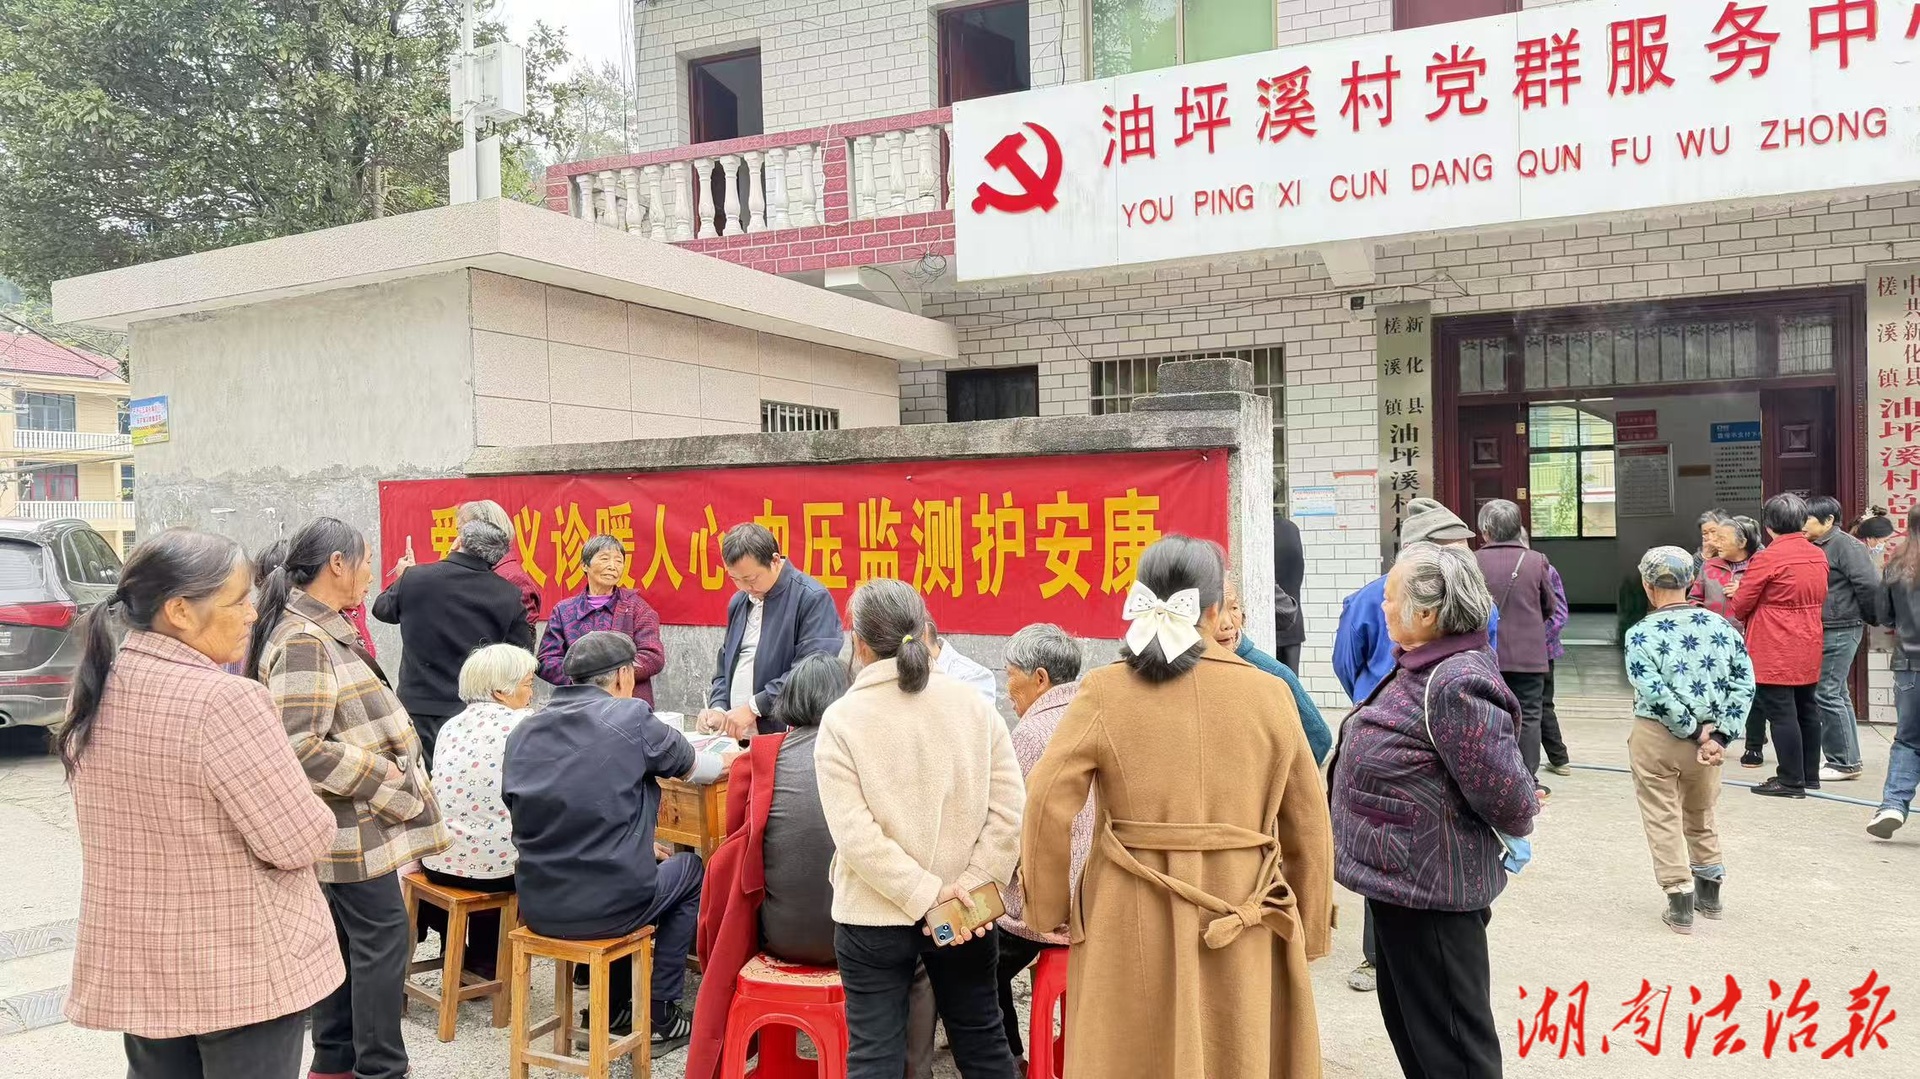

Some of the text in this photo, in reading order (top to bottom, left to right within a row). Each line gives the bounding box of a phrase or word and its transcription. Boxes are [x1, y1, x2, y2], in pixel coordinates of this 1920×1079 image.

[1102, 0, 1920, 168] 油坪溪村党群服务中
[1121, 107, 1887, 228] YOU PING XI CUN DANG QUN FU WU ZHONG
[1405, 315, 1425, 415] 新化县
